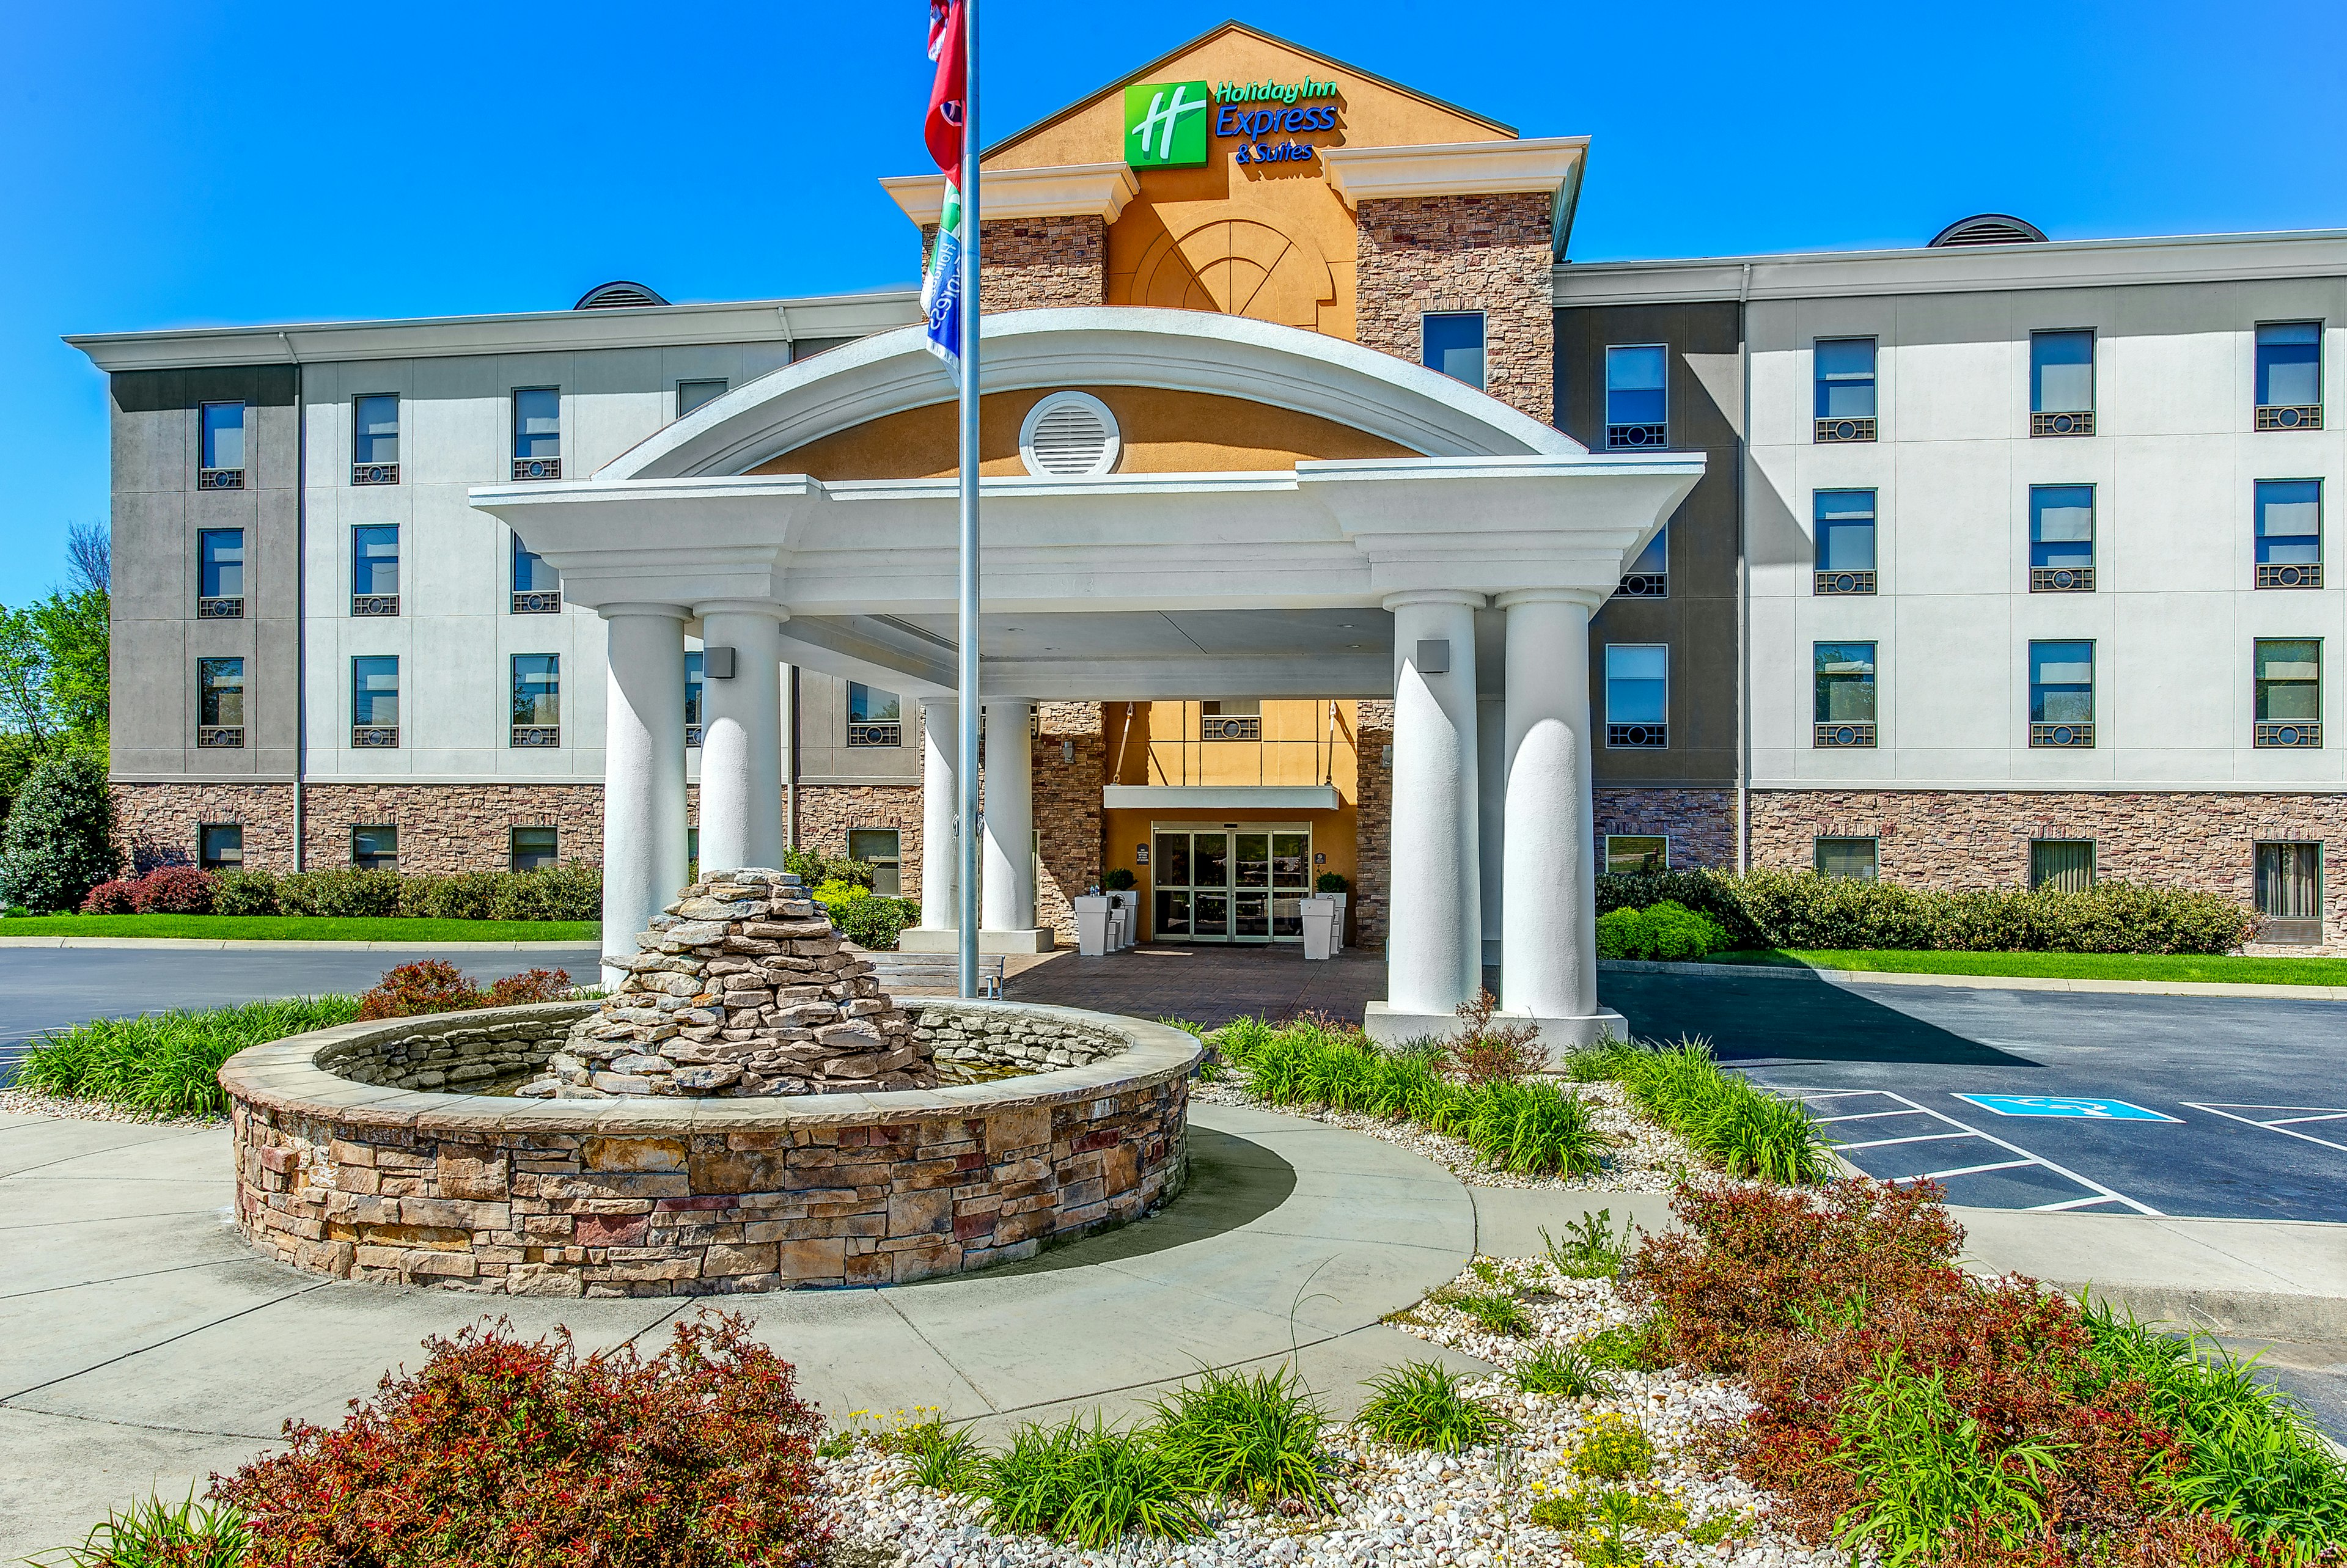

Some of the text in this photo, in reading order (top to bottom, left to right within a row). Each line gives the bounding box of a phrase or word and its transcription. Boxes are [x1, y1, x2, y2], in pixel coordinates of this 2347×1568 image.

[1214, 75, 1337, 104] Holiday Inn
[1215, 104, 1337, 142] Express
[1235, 142, 1313, 164] & Suites
